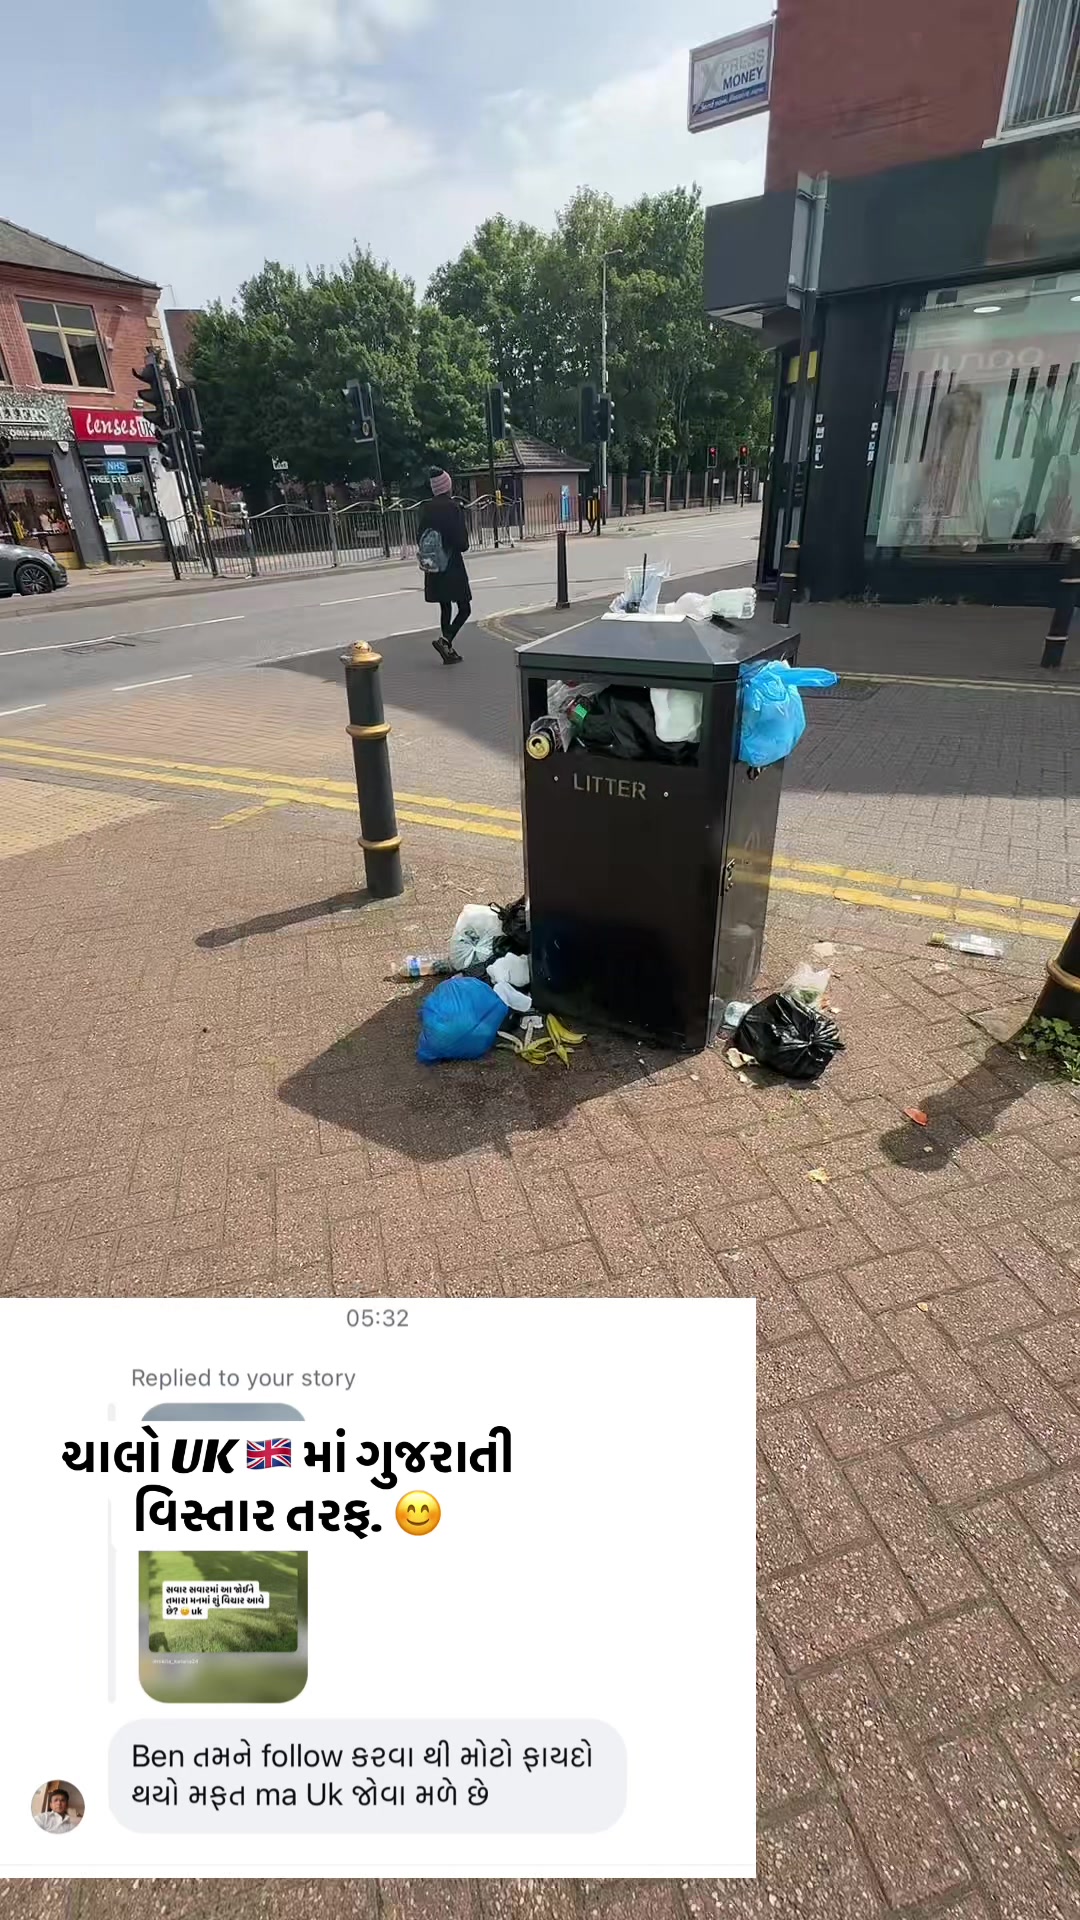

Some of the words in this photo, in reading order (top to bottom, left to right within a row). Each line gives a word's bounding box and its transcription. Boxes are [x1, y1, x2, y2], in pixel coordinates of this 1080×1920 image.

[722, 66, 764, 90] MONEY
[107, 461, 126, 470] NHS
[90, 475, 110, 484] FREE
[111, 474, 127, 483] EYE
[573, 772, 647, 800] LITTER
